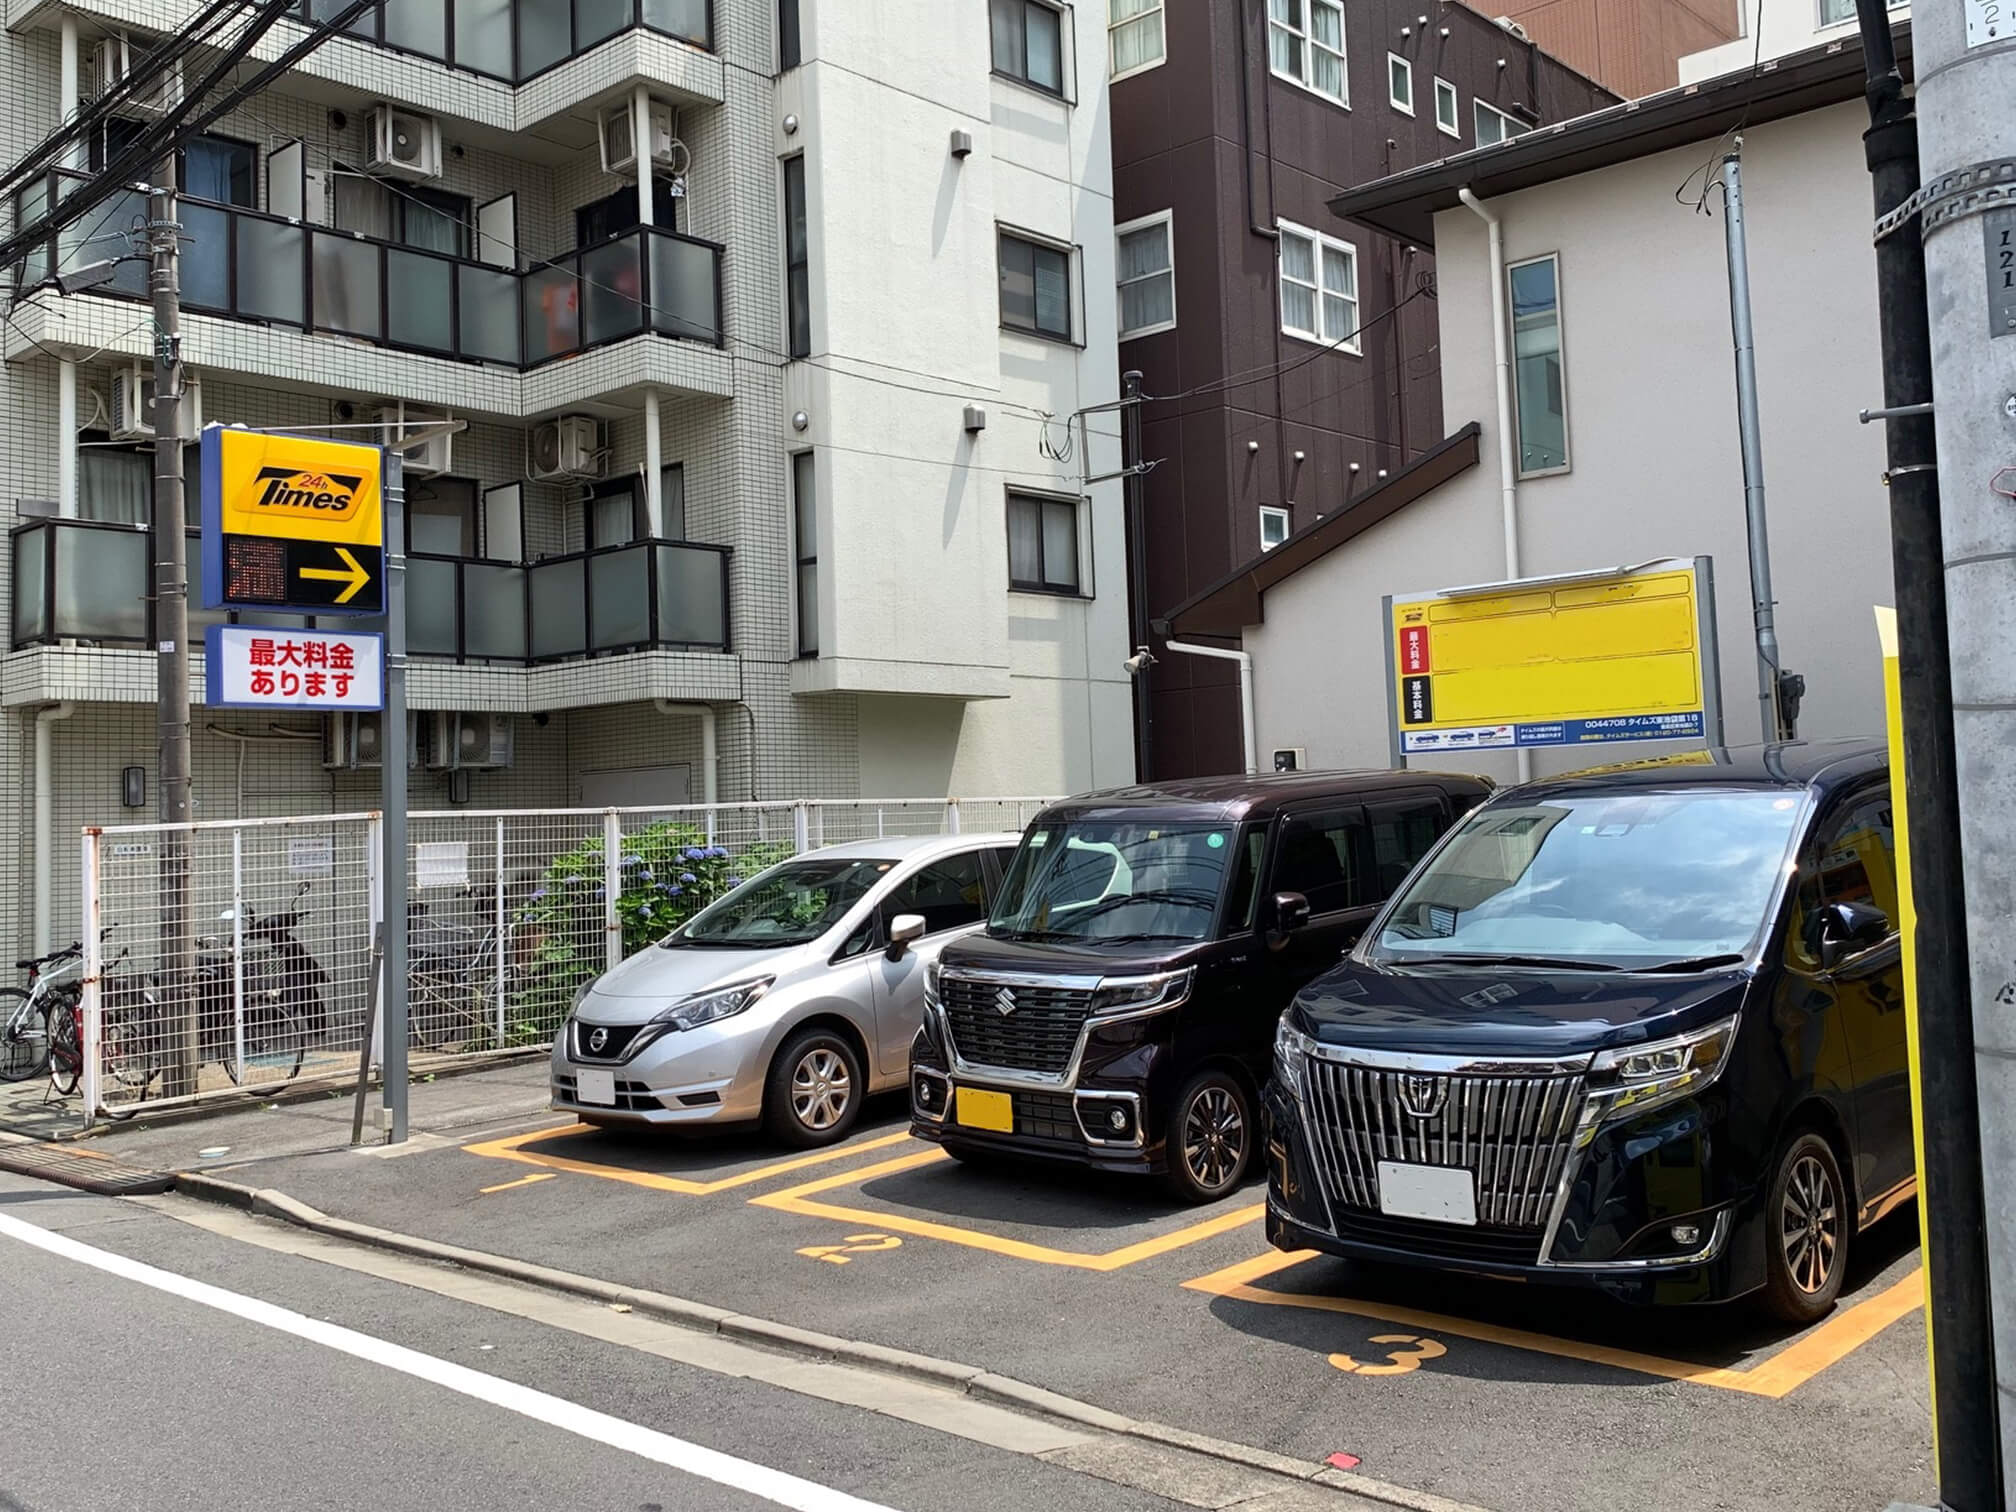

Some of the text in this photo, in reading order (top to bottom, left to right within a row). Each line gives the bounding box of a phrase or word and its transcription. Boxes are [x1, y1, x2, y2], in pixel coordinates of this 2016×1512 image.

[254, 468, 355, 512] Times
[299, 473, 328, 490] 24h
[249, 638, 355, 670] 最大料金
[250, 669, 355, 698] あります
[794, 1233, 903, 1265] 2
[1328, 1334, 1448, 1376] 3
